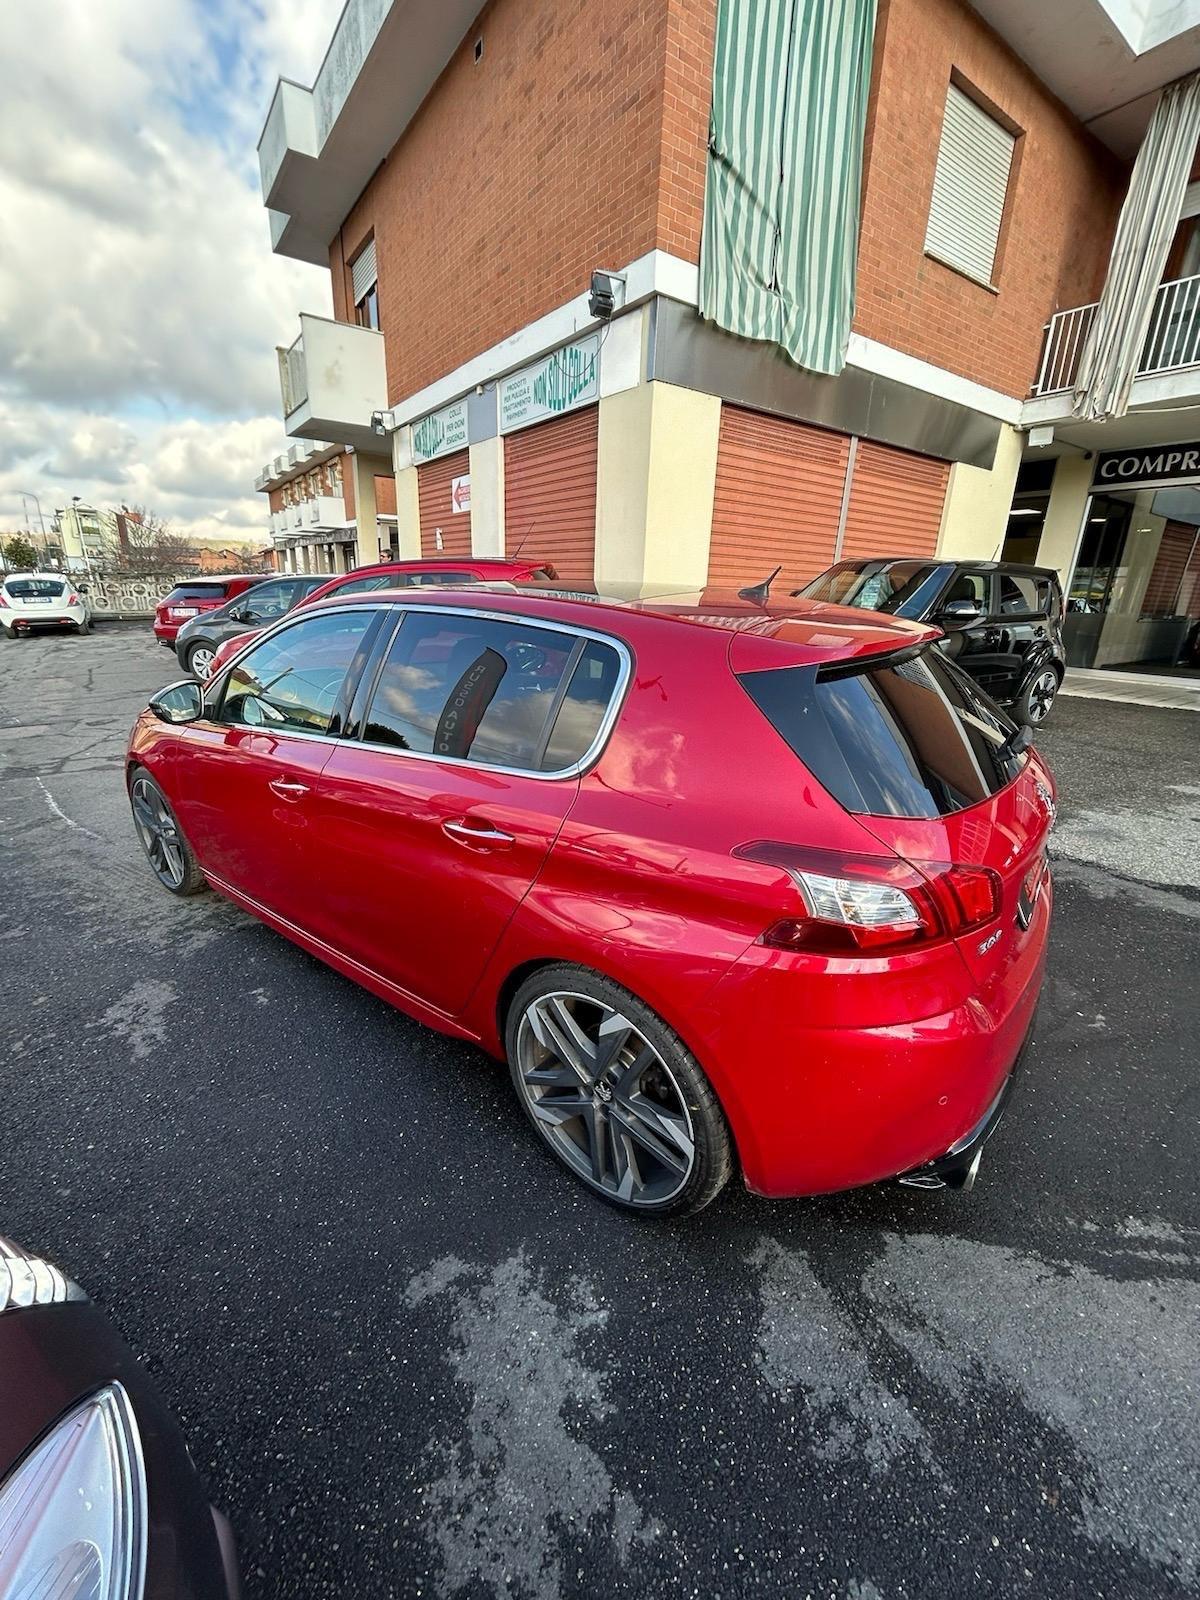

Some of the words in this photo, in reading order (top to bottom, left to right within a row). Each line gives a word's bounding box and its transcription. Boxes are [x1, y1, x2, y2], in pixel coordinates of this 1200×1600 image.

[507, 378, 527, 393] PRODOTTI
[534, 367, 547, 406] NON
[548, 348, 567, 411] SOLO
[568, 347, 595, 406] COLLA
[449, 406, 462, 418] COLLE
[447, 431, 466, 445] ESIGENZA
[1101, 450, 1200, 478] COMPR
